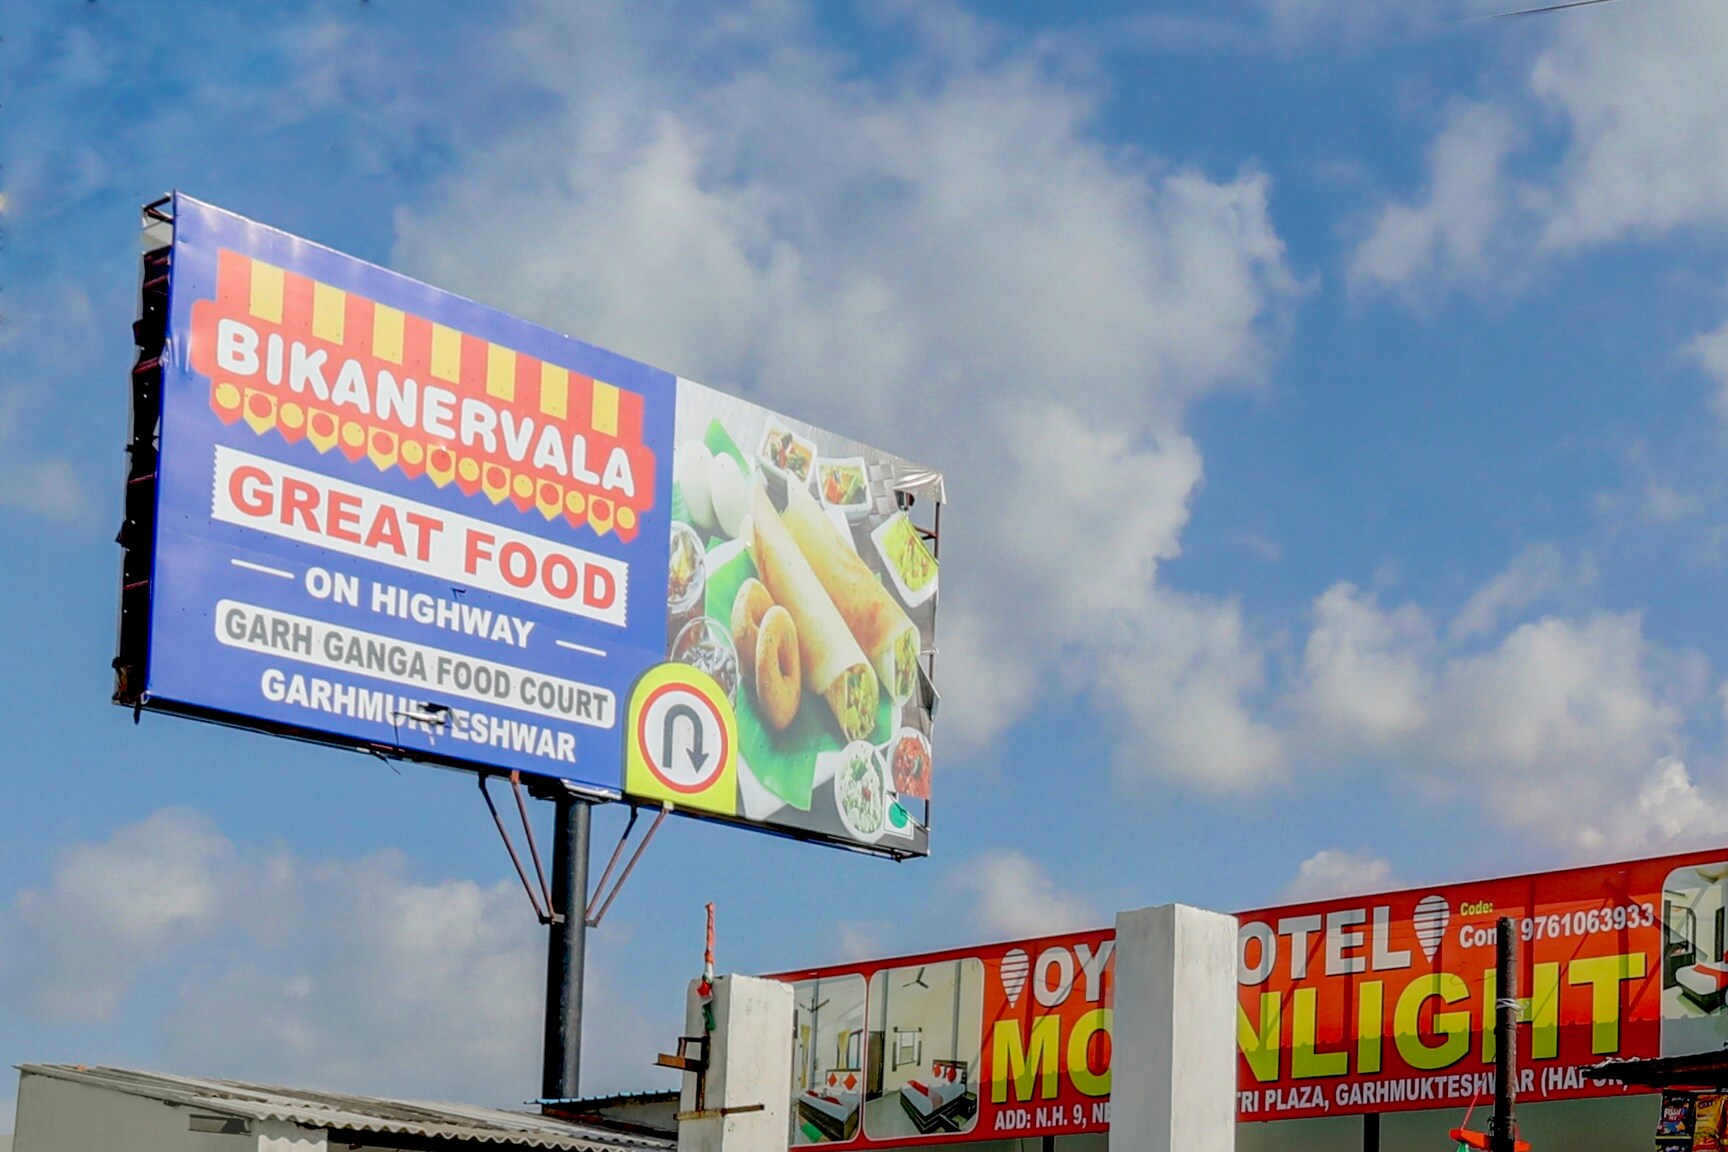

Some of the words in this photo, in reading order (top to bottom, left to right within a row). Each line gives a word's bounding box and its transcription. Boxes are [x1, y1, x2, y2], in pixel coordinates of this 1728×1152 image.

[217, 318, 636, 498] BIKANERVALA
[228, 465, 444, 563] GREAT
[464, 528, 617, 610] FOOD
[305, 567, 359, 607] ON
[371, 581, 536, 648] HIGHWAY
[224, 608, 313, 656] GARH
[323, 631, 428, 682] GANGA
[436, 657, 511, 700] FOOD
[520, 676, 608, 722] COURT
[261, 668, 576, 763] GARHMUKESHWAR
[1033, 940, 1116, 1007] OY
[1238, 905, 1412, 985] OTEL
[1459, 924, 1497, 949] Con
[1521, 903, 1654, 941] 9761063933
[1460, 901, 1493, 916] Code:
[991, 952, 1646, 1103] MONLIGHT
[994, 1109, 1031, 1130] ADD:
[1036, 1105, 1068, 1128] N.H.
[1073, 1104, 1086, 1129] 9,
[1265, 1085, 1329, 1112] PLAZA,
